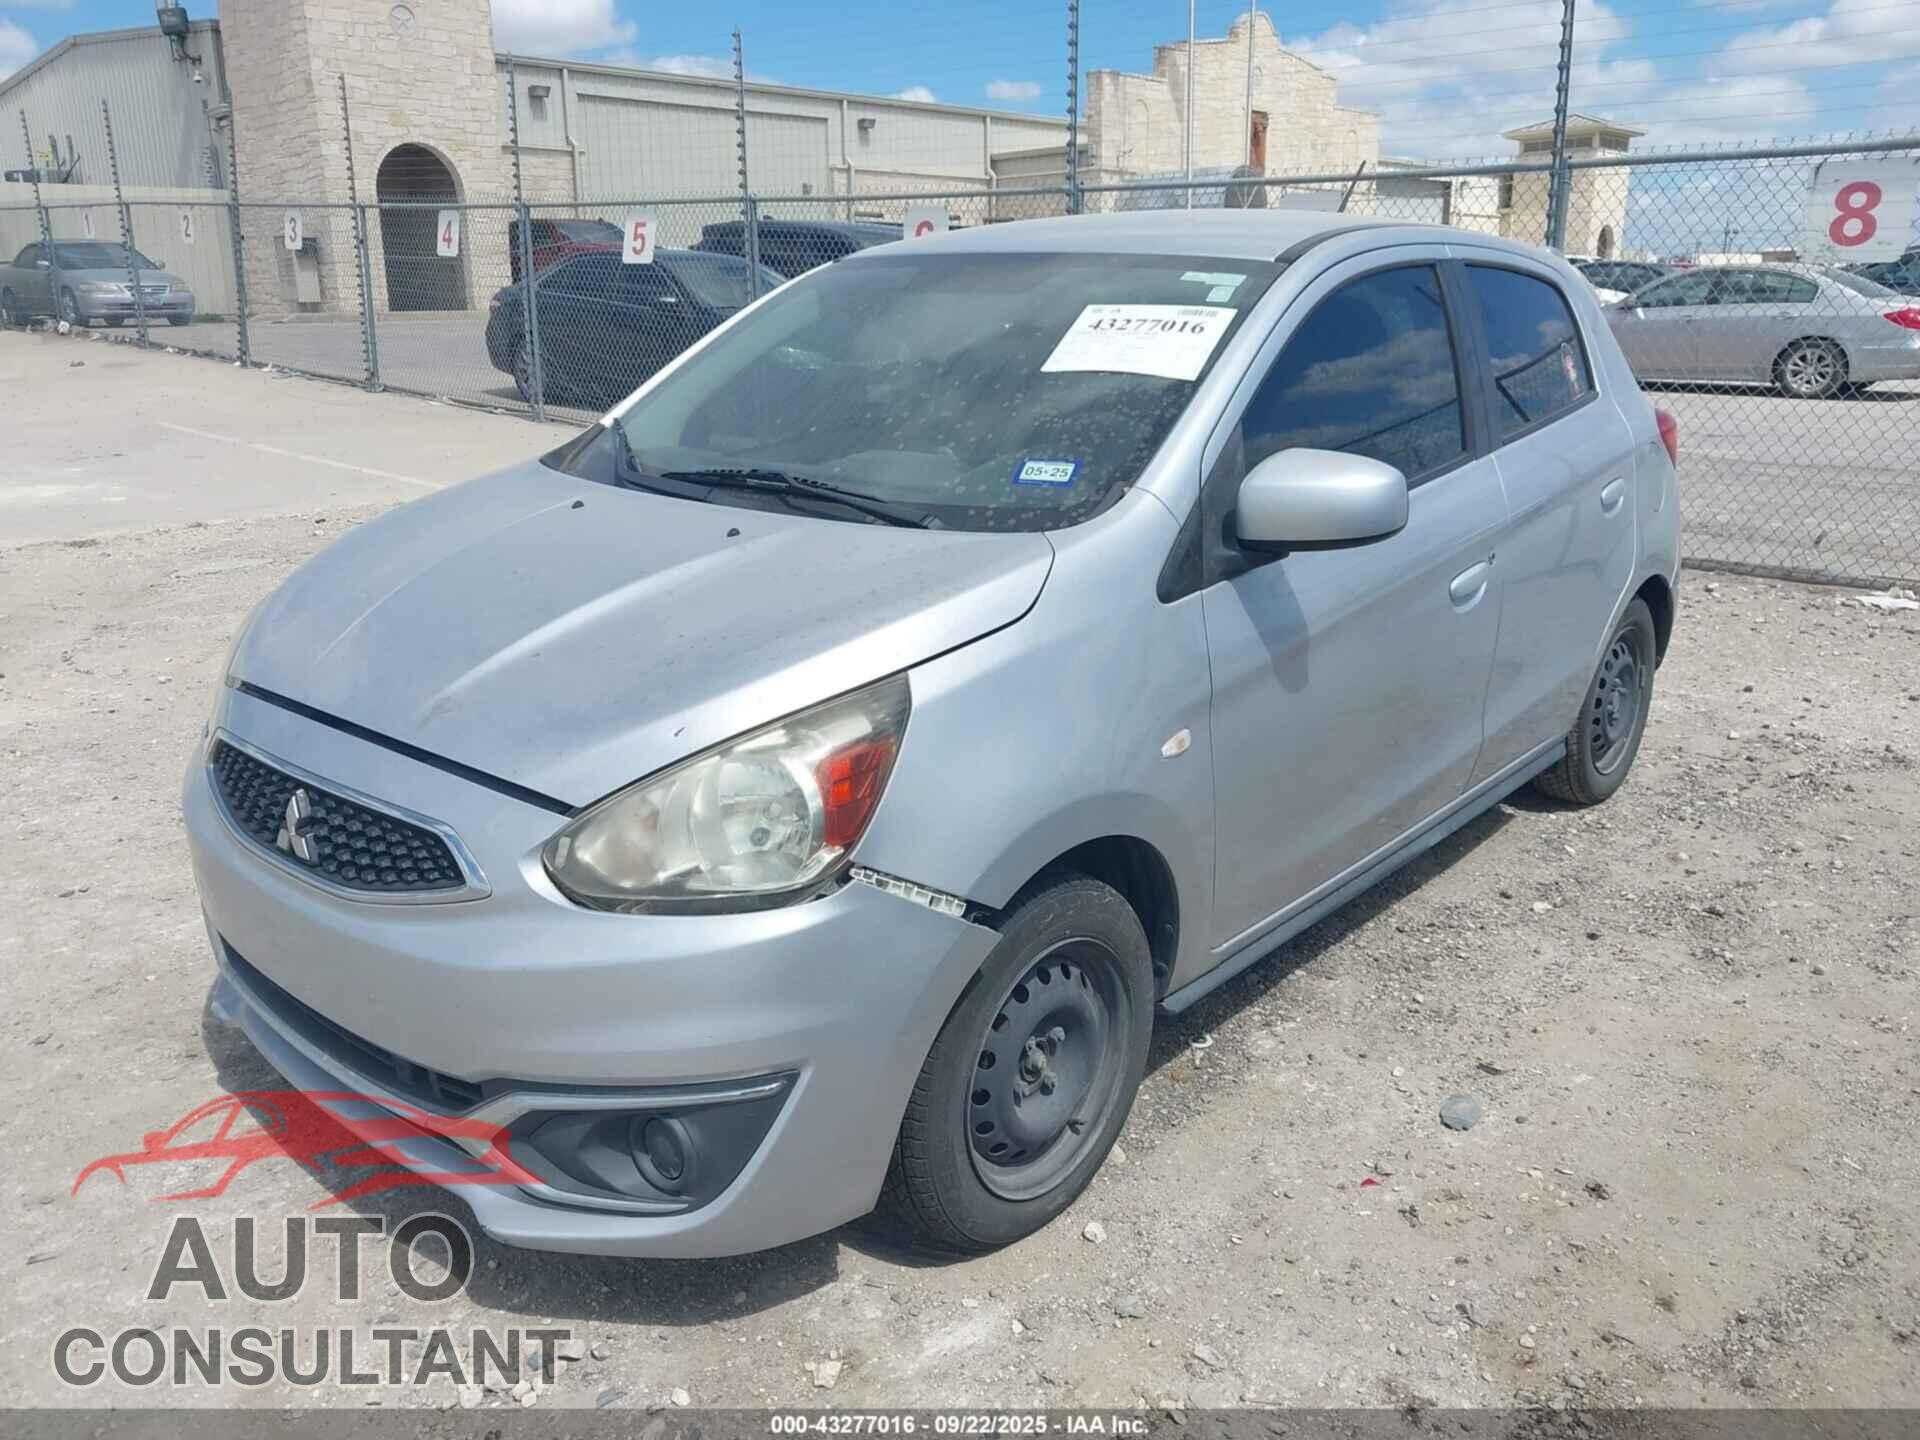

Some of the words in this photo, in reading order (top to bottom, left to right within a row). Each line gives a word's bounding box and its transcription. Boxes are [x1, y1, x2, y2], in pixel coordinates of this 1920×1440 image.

[182, 214, 192, 238] 2
[1828, 180, 1883, 248] 8
[289, 216, 298, 243] 3
[441, 219, 454, 249] 4
[631, 221, 648, 256] 5
[1087, 318, 1206, 334] 43277016
